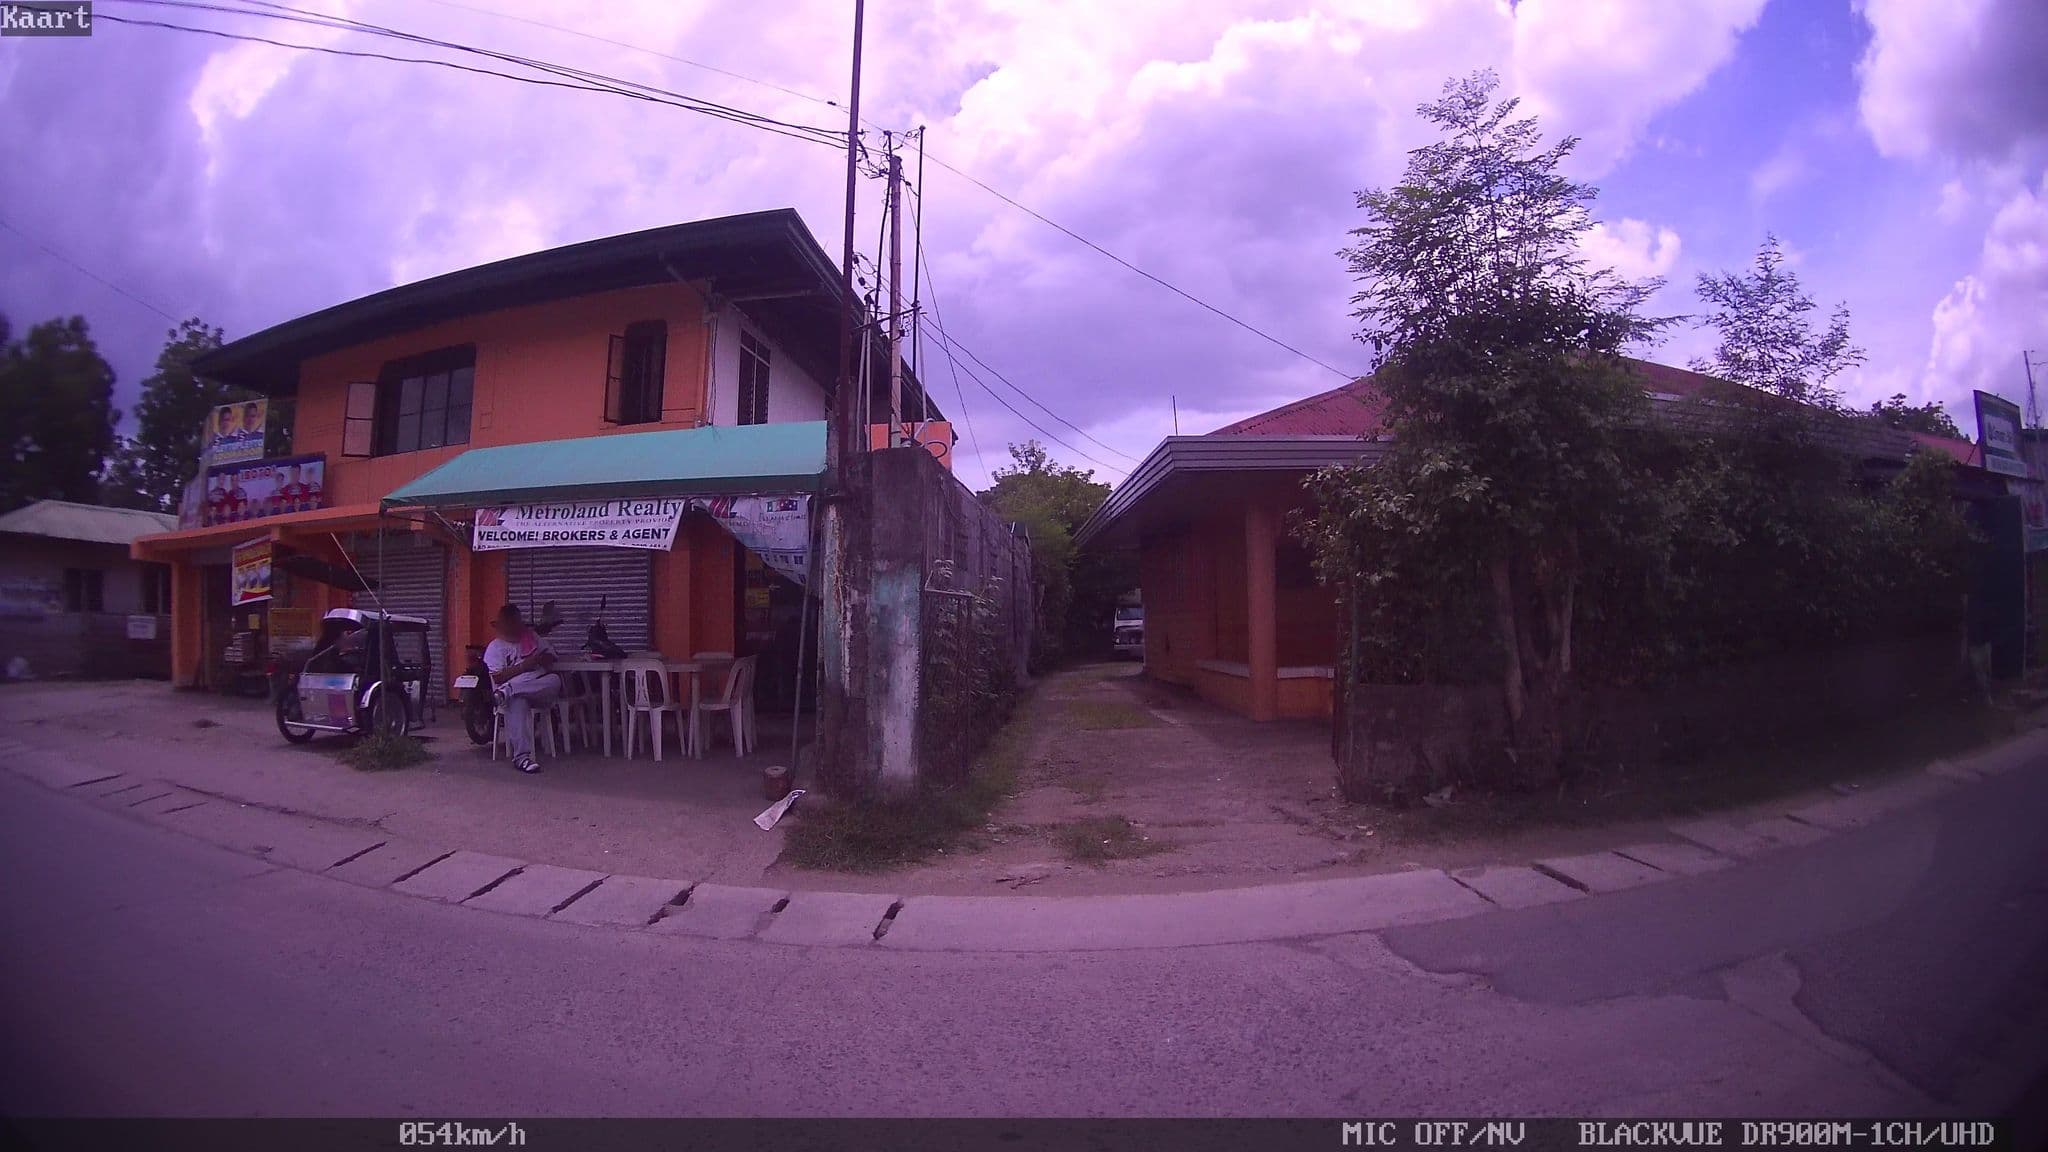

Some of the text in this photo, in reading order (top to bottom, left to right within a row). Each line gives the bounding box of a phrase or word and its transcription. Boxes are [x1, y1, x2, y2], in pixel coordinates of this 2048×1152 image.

[515, 499, 681, 520] Metroland Realty
[543, 529, 605, 541] BROKERS
[609, 529, 618, 540] &
[622, 527, 670, 540] AGENT
